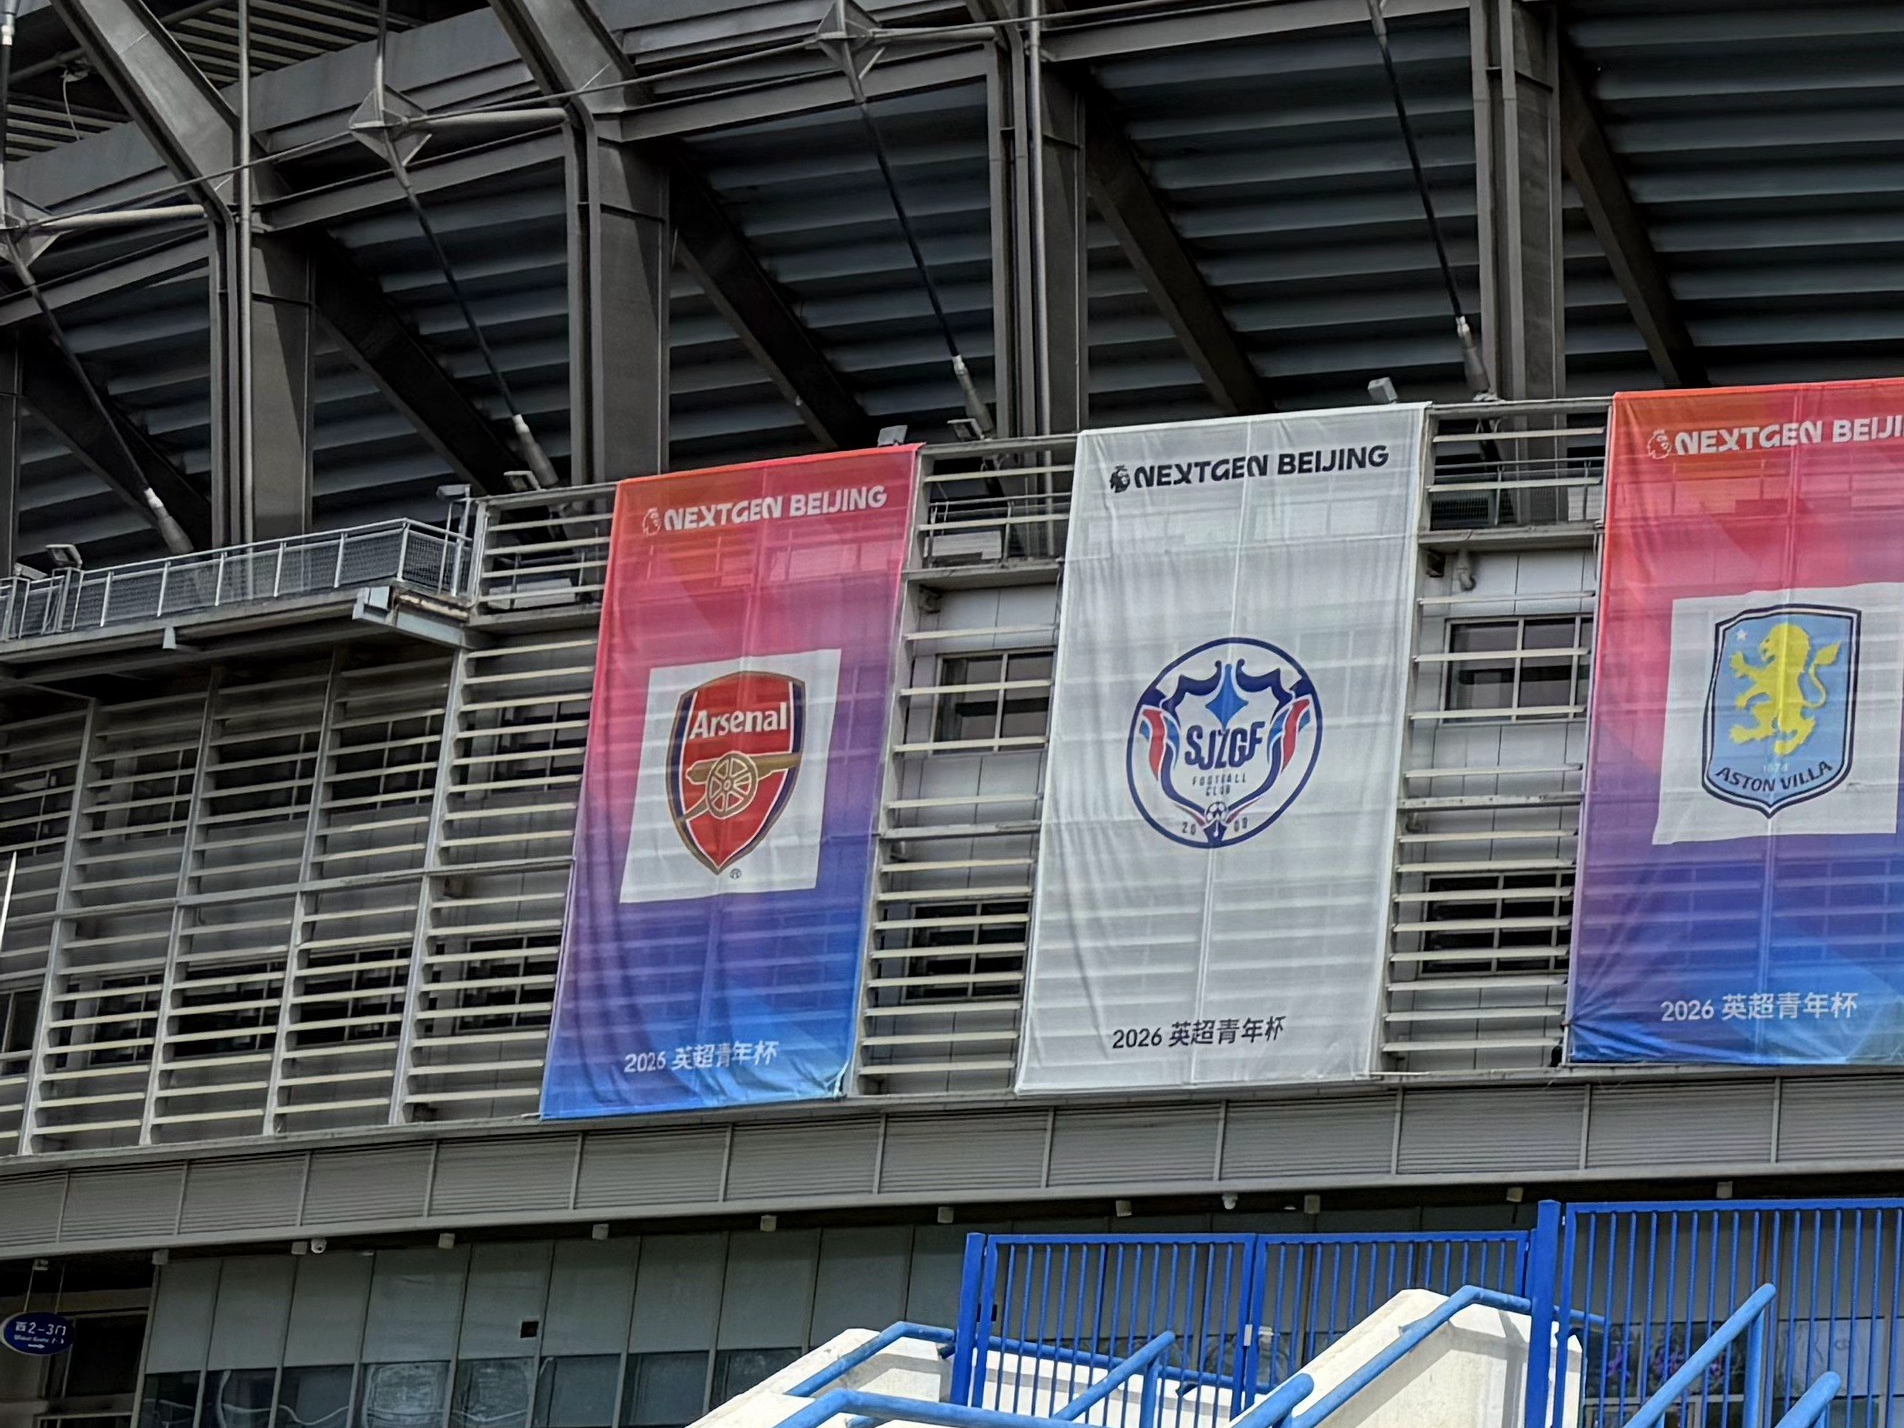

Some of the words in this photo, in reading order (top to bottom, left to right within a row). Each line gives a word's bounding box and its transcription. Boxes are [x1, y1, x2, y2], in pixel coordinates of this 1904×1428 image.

[1675, 420, 1823, 455] NEXTGEN
[1134, 454, 1268, 489] NEXTGEN
[1277, 444, 1389, 475] BEIJING
[664, 495, 783, 531] NEXTGEN
[790, 485, 887, 517] BEIJING
[689, 702, 787, 740] Arsenal
[1715, 766, 1775, 792] ASTON
[1780, 760, 1833, 791] VILLA
[1660, 999, 1714, 1022] 2026
[1722, 991, 1859, 1021] 英超青年杯
[1112, 1028, 1162, 1049] 2026
[1168, 1015, 1286, 1047] 英超青年杯
[624, 1051, 666, 1072] 2026
